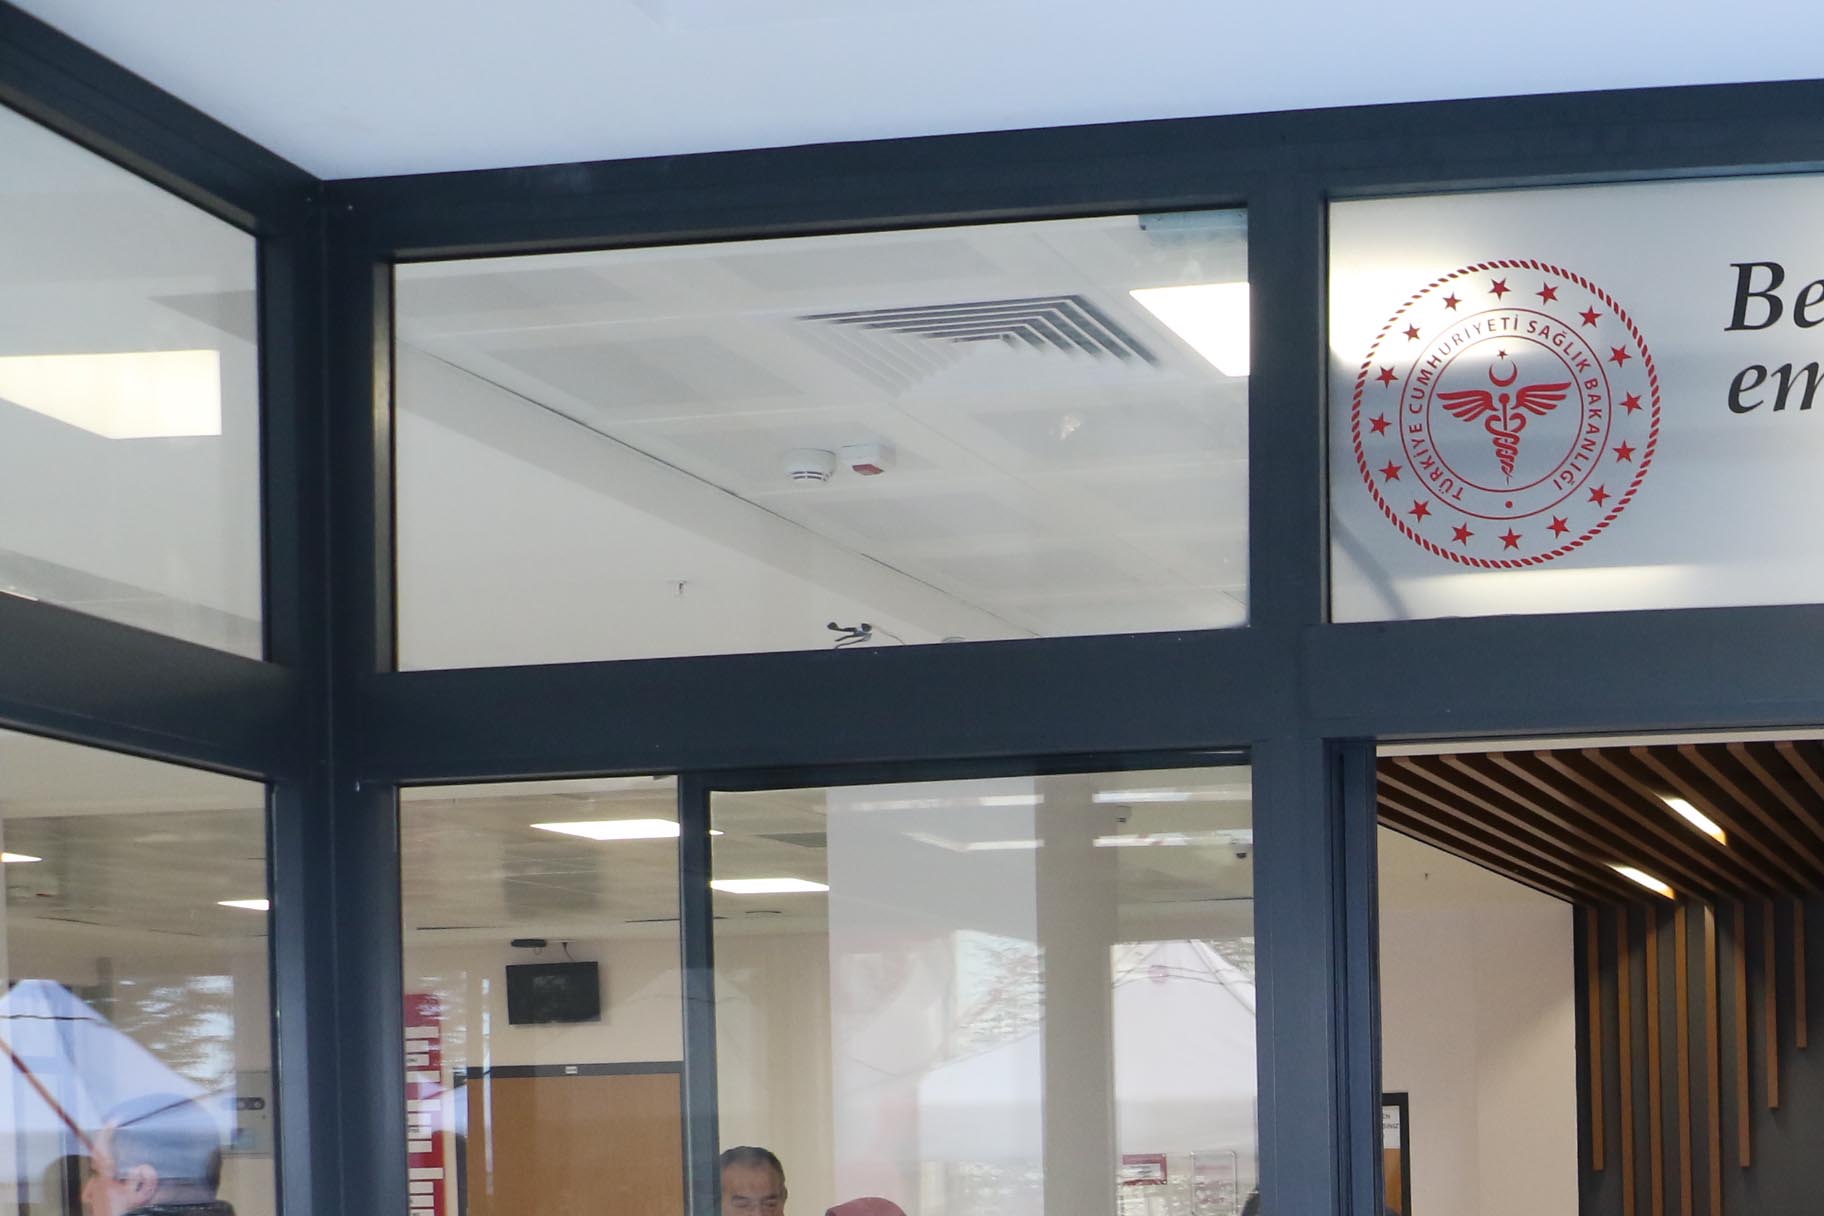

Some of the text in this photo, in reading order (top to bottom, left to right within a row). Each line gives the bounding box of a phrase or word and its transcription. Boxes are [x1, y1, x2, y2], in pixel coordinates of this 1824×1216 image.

[1408, 314, 1603, 501] TÜRKİYE CUMHURİYETİ SAĞLIK BAKANLIĞI
